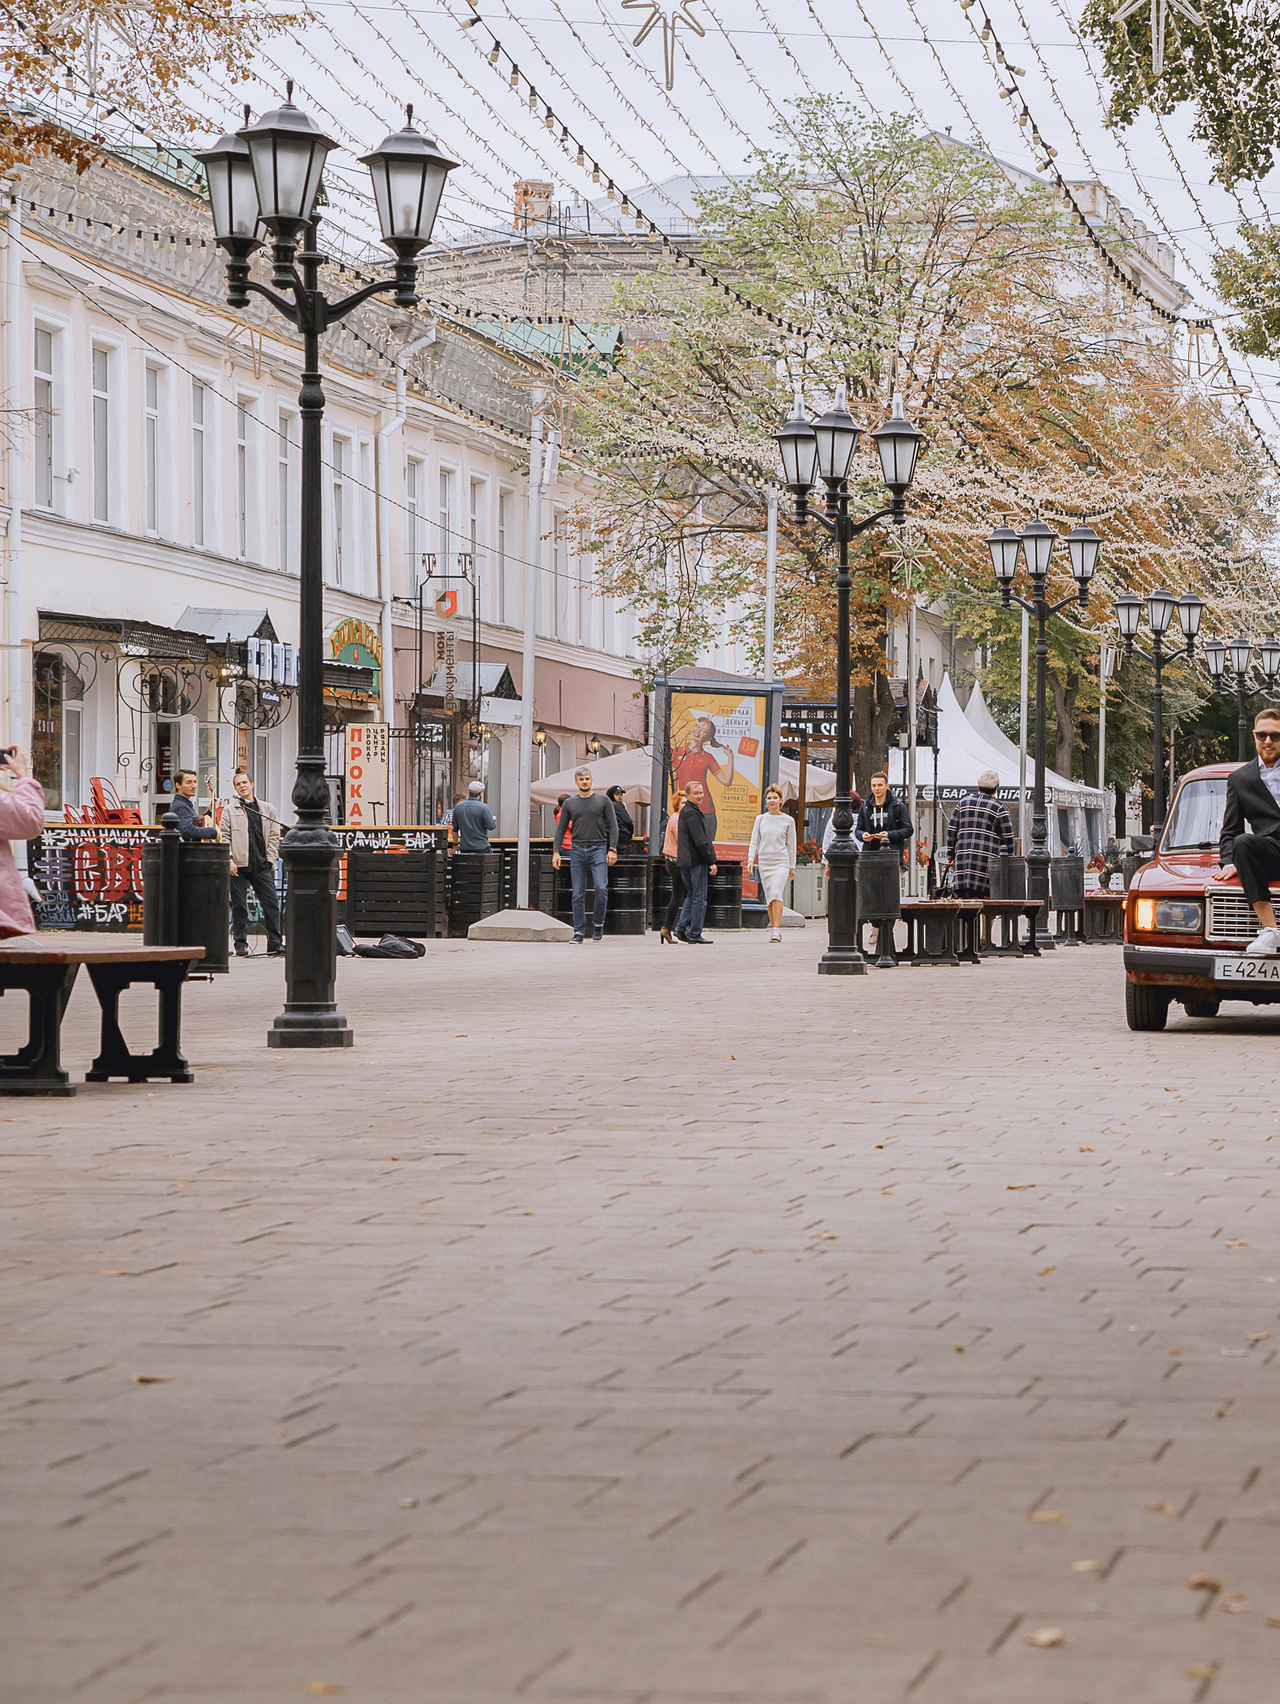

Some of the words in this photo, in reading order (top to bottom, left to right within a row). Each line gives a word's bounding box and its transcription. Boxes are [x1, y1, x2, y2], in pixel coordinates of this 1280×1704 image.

[446, 631, 457, 711] документы
[725, 718, 749, 726] ДЕНЬГИ
[742, 741, 755, 752] 150
[349, 728, 363, 826] ПРОКА
[942, 788, 967, 799] БАР
[346, 830, 391, 849] САМЫЙ
[402, 831, 436, 849] БАР!
[937, 851, 948, 859] CR
